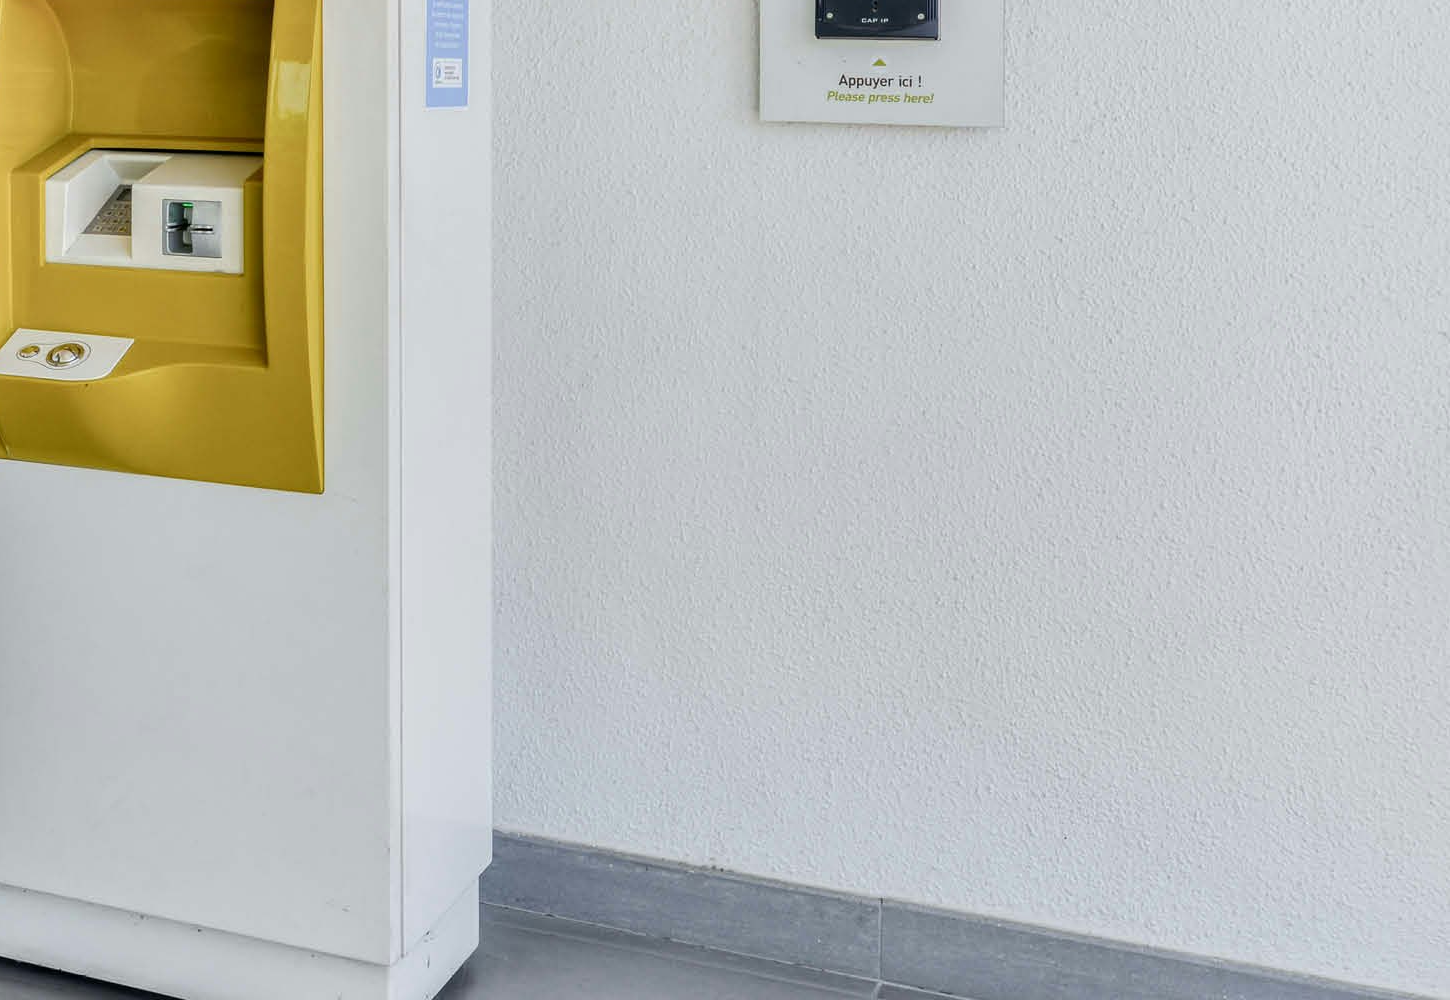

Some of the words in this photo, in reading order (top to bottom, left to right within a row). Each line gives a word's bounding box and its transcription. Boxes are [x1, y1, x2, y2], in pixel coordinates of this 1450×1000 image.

[838, 74, 894, 89] Appuyer
[898, 75, 913, 87] ici
[918, 75, 922, 88] !
[826, 90, 865, 102] Please
[868, 93, 901, 104] press
[903, 93, 935, 104] here!
